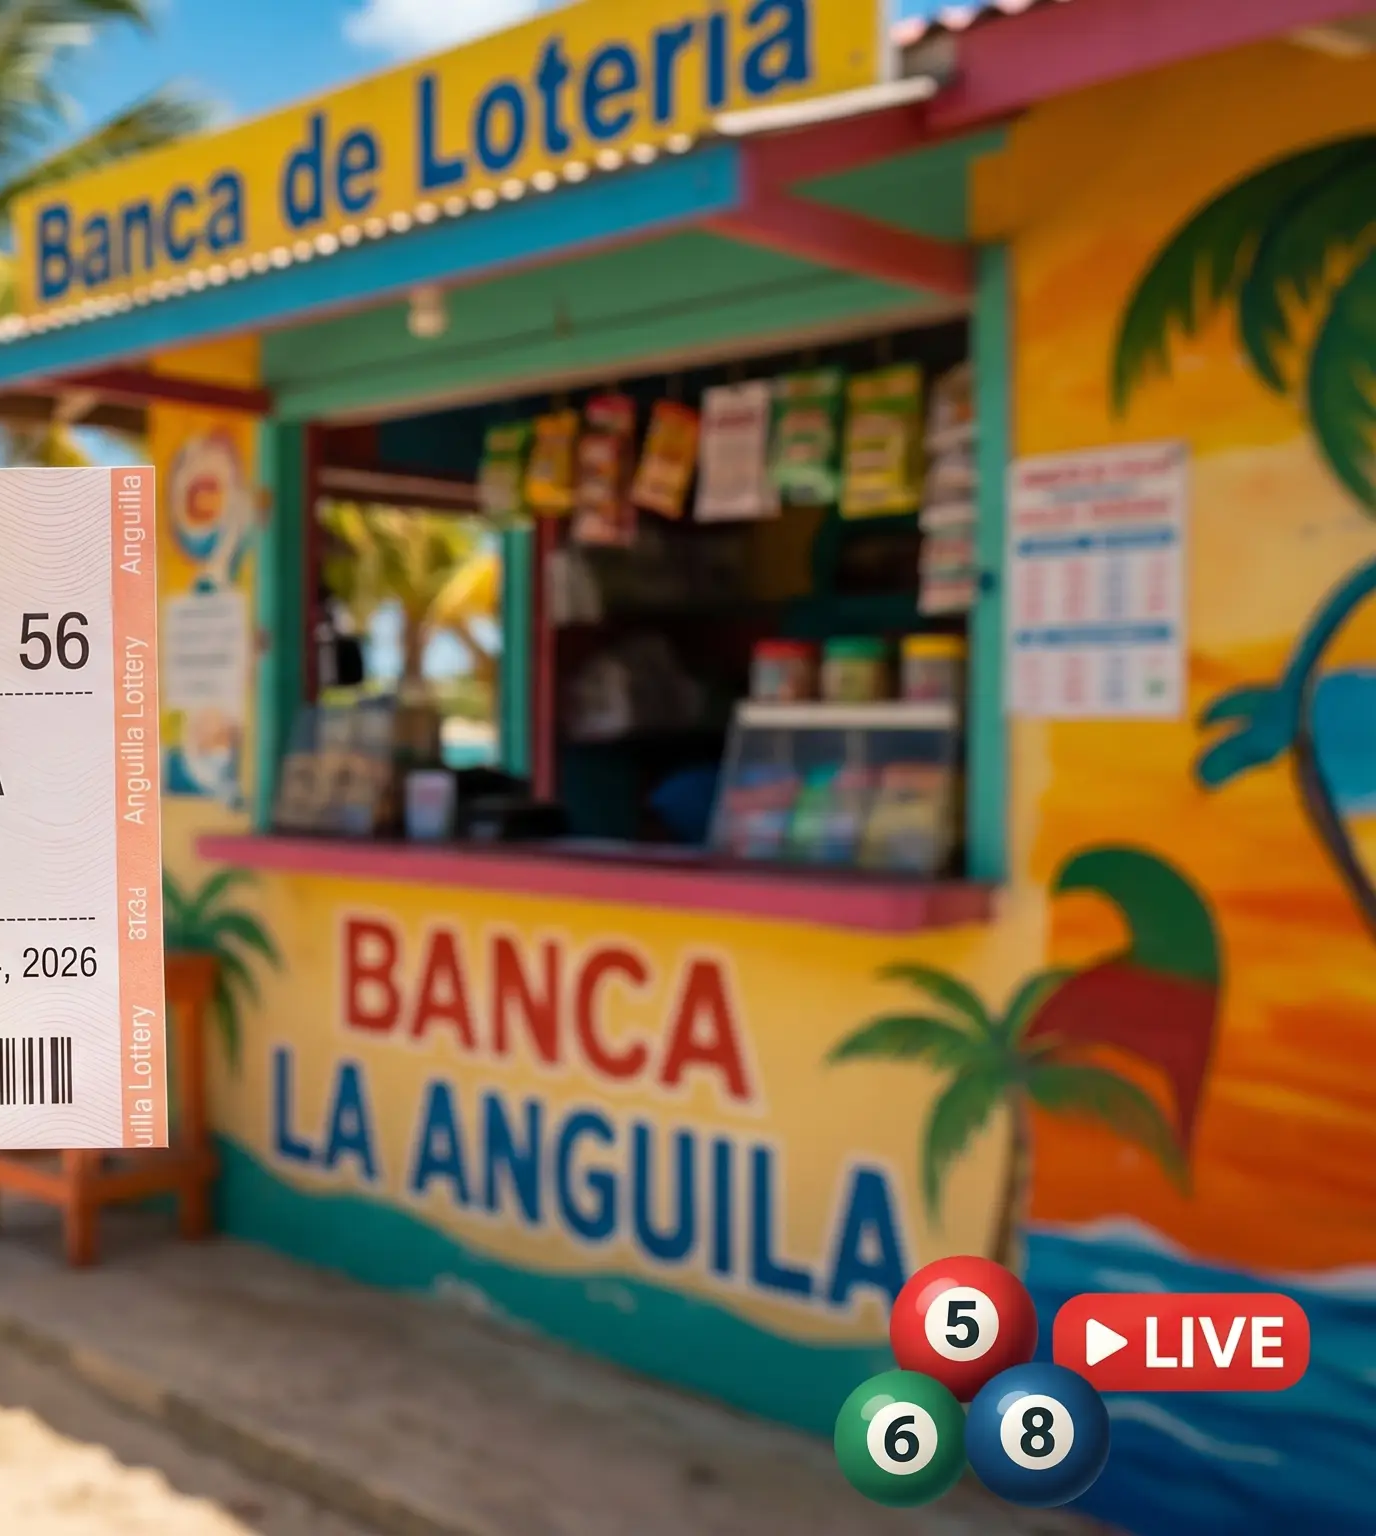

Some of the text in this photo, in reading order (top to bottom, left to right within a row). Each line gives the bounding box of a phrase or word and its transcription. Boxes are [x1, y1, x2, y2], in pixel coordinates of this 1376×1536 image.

[35, 170, 245, 301] Banca
[283, 114, 379, 228] de
[119, 475, 145, 575] Anguilla
[19, 611, 90, 671] 56
[122, 636, 152, 825] Anguilla Lottery
[22, 946, 97, 978] 2026
[343, 916, 753, 1101] BANCA
[128, 1004, 156, 1090] Lottery
[274, 1048, 909, 1310] LA ANGUILA
